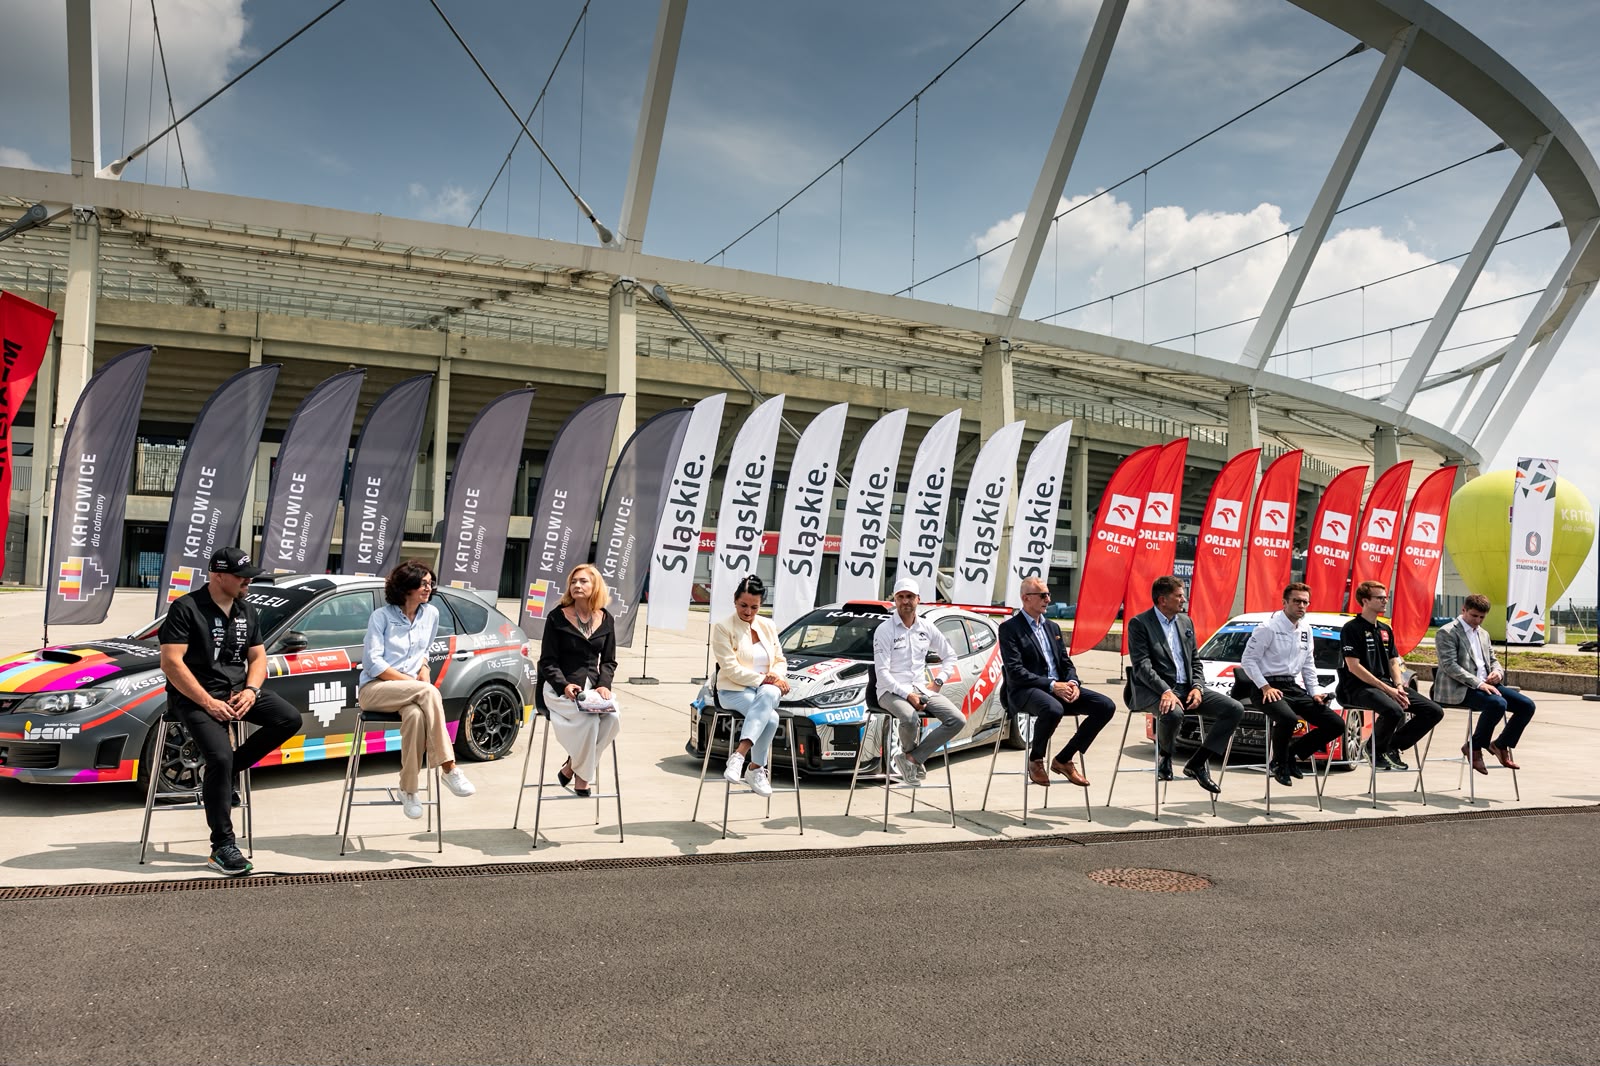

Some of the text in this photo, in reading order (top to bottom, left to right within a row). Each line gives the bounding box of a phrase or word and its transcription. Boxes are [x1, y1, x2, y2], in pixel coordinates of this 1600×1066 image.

[71, 453, 96, 548] KATOWICE
[91, 494, 106, 548] dla odmiany
[183, 466, 217, 558] KATOWICE
[278, 472, 306, 560] KATOWICE
[358, 476, 381, 564] KATOWICE
[656, 454, 706, 574] Śląskie.
[720, 454, 766, 572] Śląskie.
[782, 462, 829, 578] Śląskie.
[844, 466, 890, 578] Śląskie.
[903, 467, 946, 578] Śląskie.
[205, 508, 222, 544] odmiany
[296, 512, 314, 562] dla odmiany
[374, 515, 390, 564] dla odmiany
[454, 488, 480, 573] KATOWICE
[540, 488, 568, 572] KATOWICE
[556, 526, 573, 573] dla odmiany
[602, 496, 634, 578] KATOWICE
[959, 476, 1006, 584] Śląskie.
[1013, 476, 1056, 580] Śląskie.
[1097, 530, 1136, 548] ORLEN
[1106, 544, 1120, 554] OIL
[1146, 542, 1160, 551] OIL
[1204, 534, 1241, 548] ORLEN
[1254, 536, 1290, 549] ORLEN
[1361, 542, 1394, 556] ORLEN
[200, 546, 212, 560] dla
[472, 526, 487, 574] dla odmiany
[617, 534, 636, 580] dla odmiany
[1213, 547, 1227, 556] OIL
[1264, 549, 1278, 558] OIL
[1314, 544, 1350, 561] ORLEN
[1324, 557, 1337, 567] OIL
[1369, 554, 1382, 563] OIL
[1405, 546, 1440, 559] ORLEN
[1414, 557, 1427, 566] OIL
[826, 707, 860, 723] Delphi
